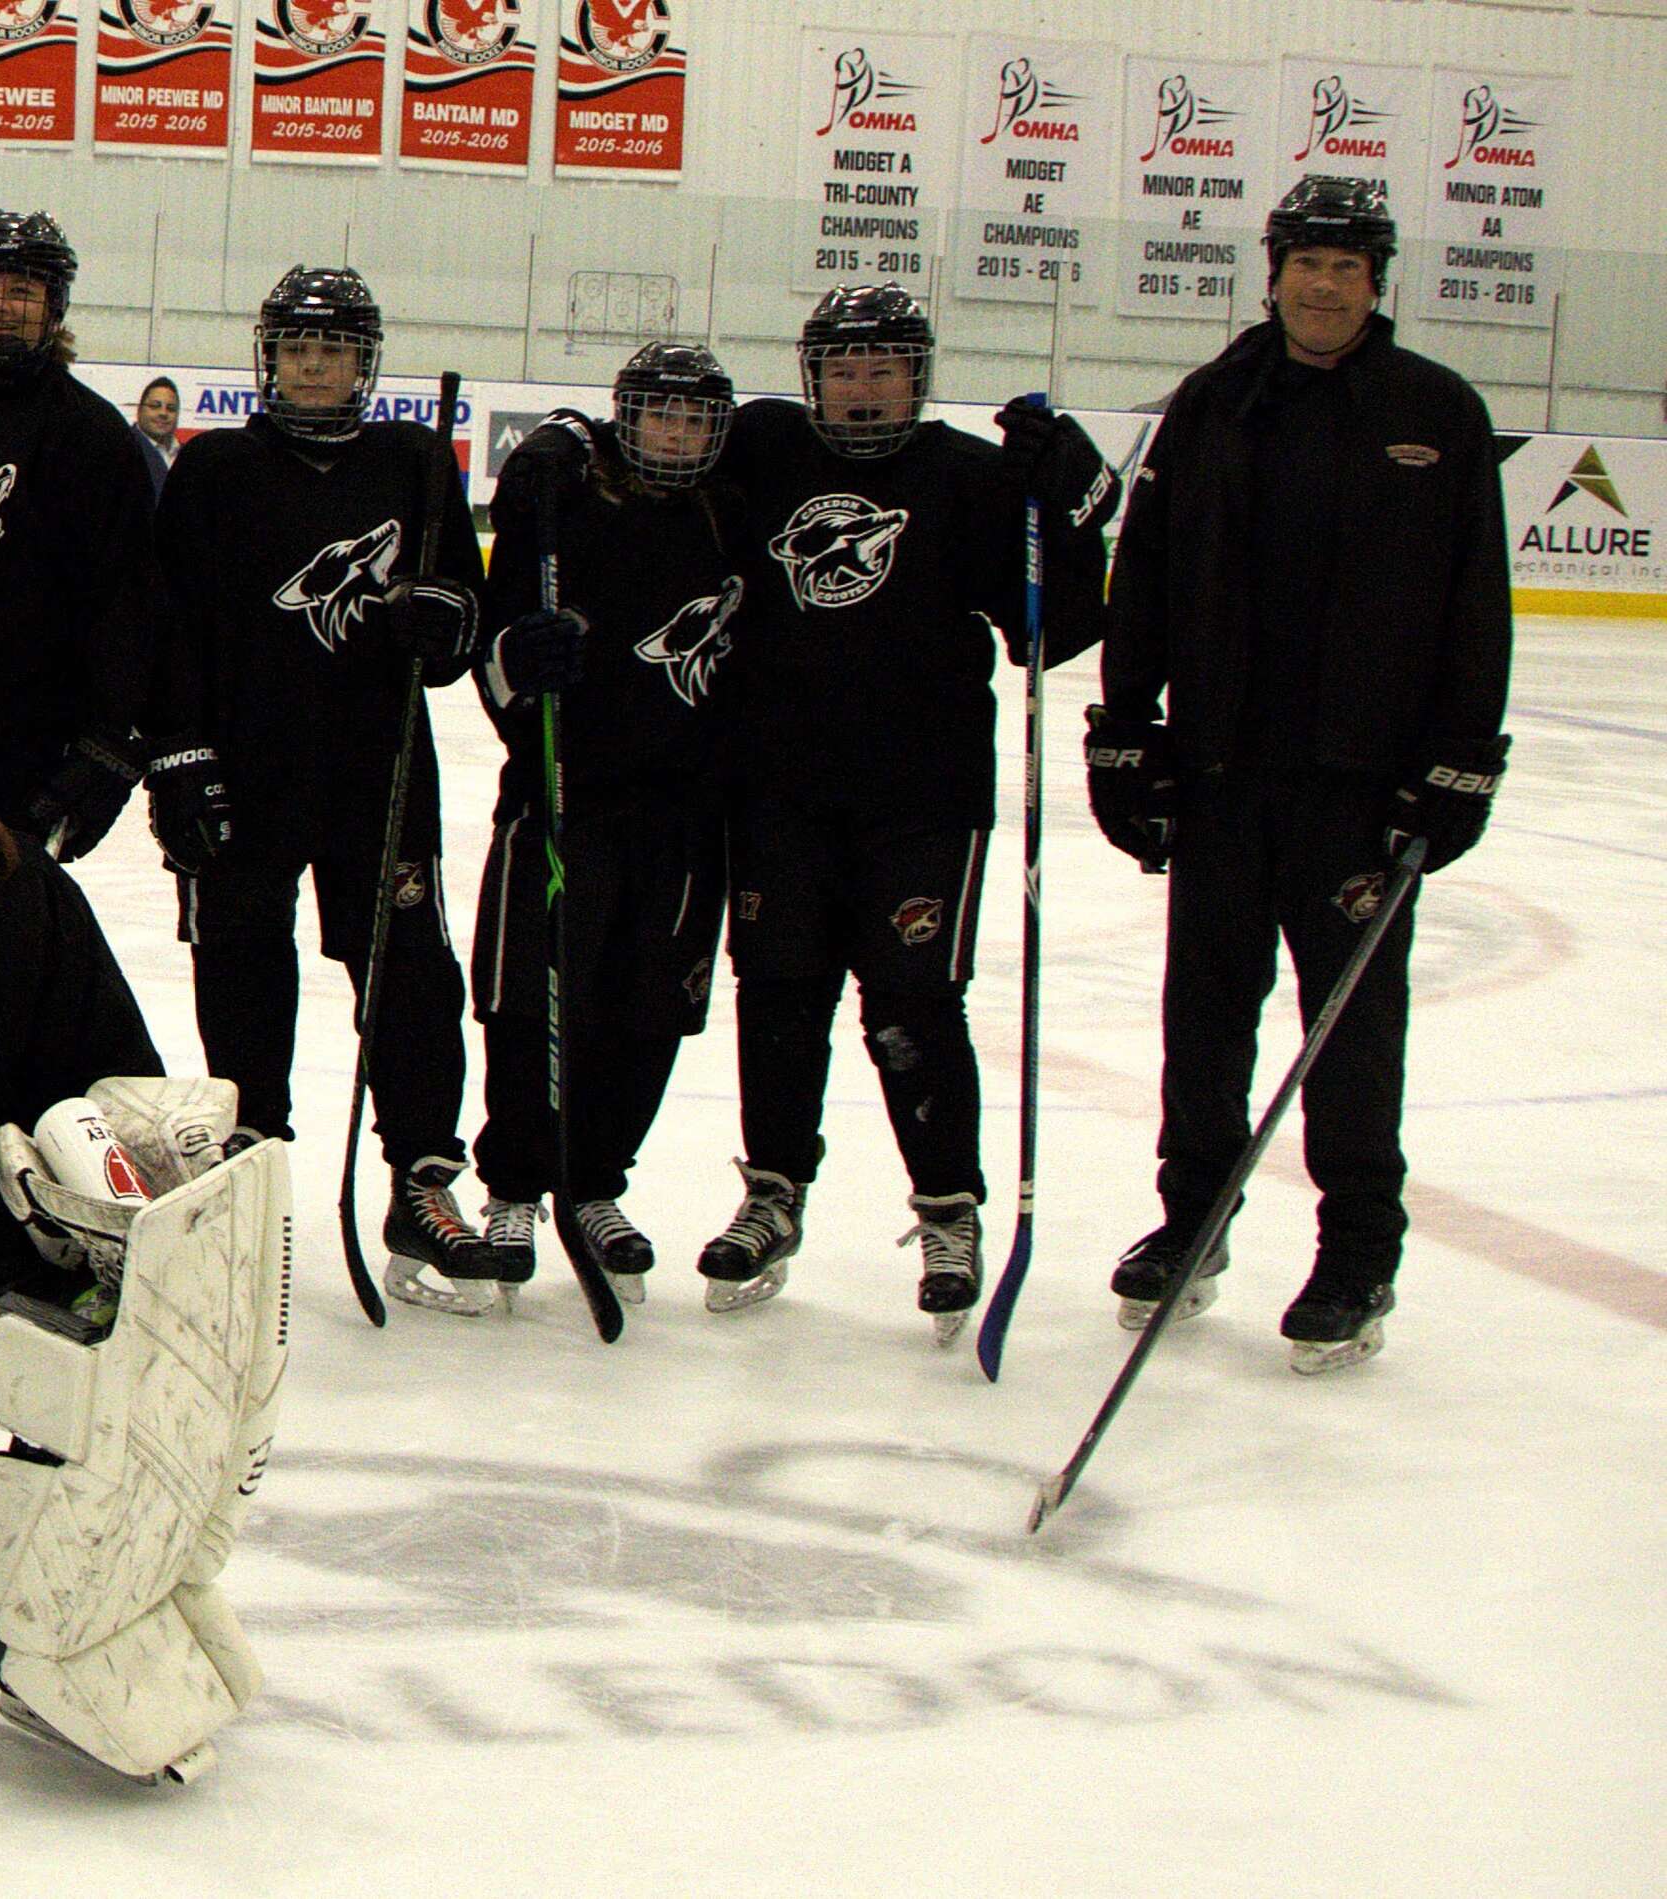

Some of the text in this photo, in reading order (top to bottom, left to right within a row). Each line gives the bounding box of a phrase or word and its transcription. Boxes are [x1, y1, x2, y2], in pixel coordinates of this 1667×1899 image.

[131, 23, 203, 45] MINOR HOCKEY
[289, 32, 357, 55] MINOR HOCKEY
[438, 40, 505, 64] MINOR HOCKEY
[591, 48, 657, 72] MINOR HOCKEY
[101, 84, 224, 109] MINOR PEEWEE MD
[261, 94, 375, 119] MINOR BANTAM MD
[413, 102, 520, 127] BANTAM MD
[569, 110, 669, 134] MIDGET MD
[848, 111, 917, 132] OMHA
[272, 120, 363, 141] 2015-2016
[420, 128, 509, 150] 2015-2016
[1012, 120, 1080, 142] OMHA
[575, 136, 663, 155] 2015-2016
[1170, 136, 1234, 159] OMHA
[1324, 136, 1387, 159] OMHA
[1473, 145, 1536, 168] OMHA
[833, 149, 912, 174] MIDGET A
[1005, 158, 1067, 182] MIDGET
[823, 182, 919, 208] TRI-COUNTY
[1142, 173, 1244, 200] MINOR ATOM
[1445, 180, 1545, 210] MINOR ATOM
[1022, 193, 1045, 215] AE
[820, 215, 919, 241] CHAMPIONS
[1182, 210, 1202, 231] AE
[1481, 216, 1503, 238] AA
[983, 222, 1080, 250] CHAMPIONS
[816, 248, 859, 270] 2015
[878, 252, 921, 274] 2016
[1143, 239, 1236, 266] CHAMPIONS
[1444, 246, 1535, 273] CHAMPIONS
[976, 255, 1020, 278] 2015
[1039, 259, 1081, 282] 206
[1138, 273, 1181, 295] 2015
[1439, 278, 1481, 300] 2015
[1494, 282, 1535, 305] 2016
[1518, 524, 1652, 558] ALLURE
[1512, 560, 1618, 579] echanical
